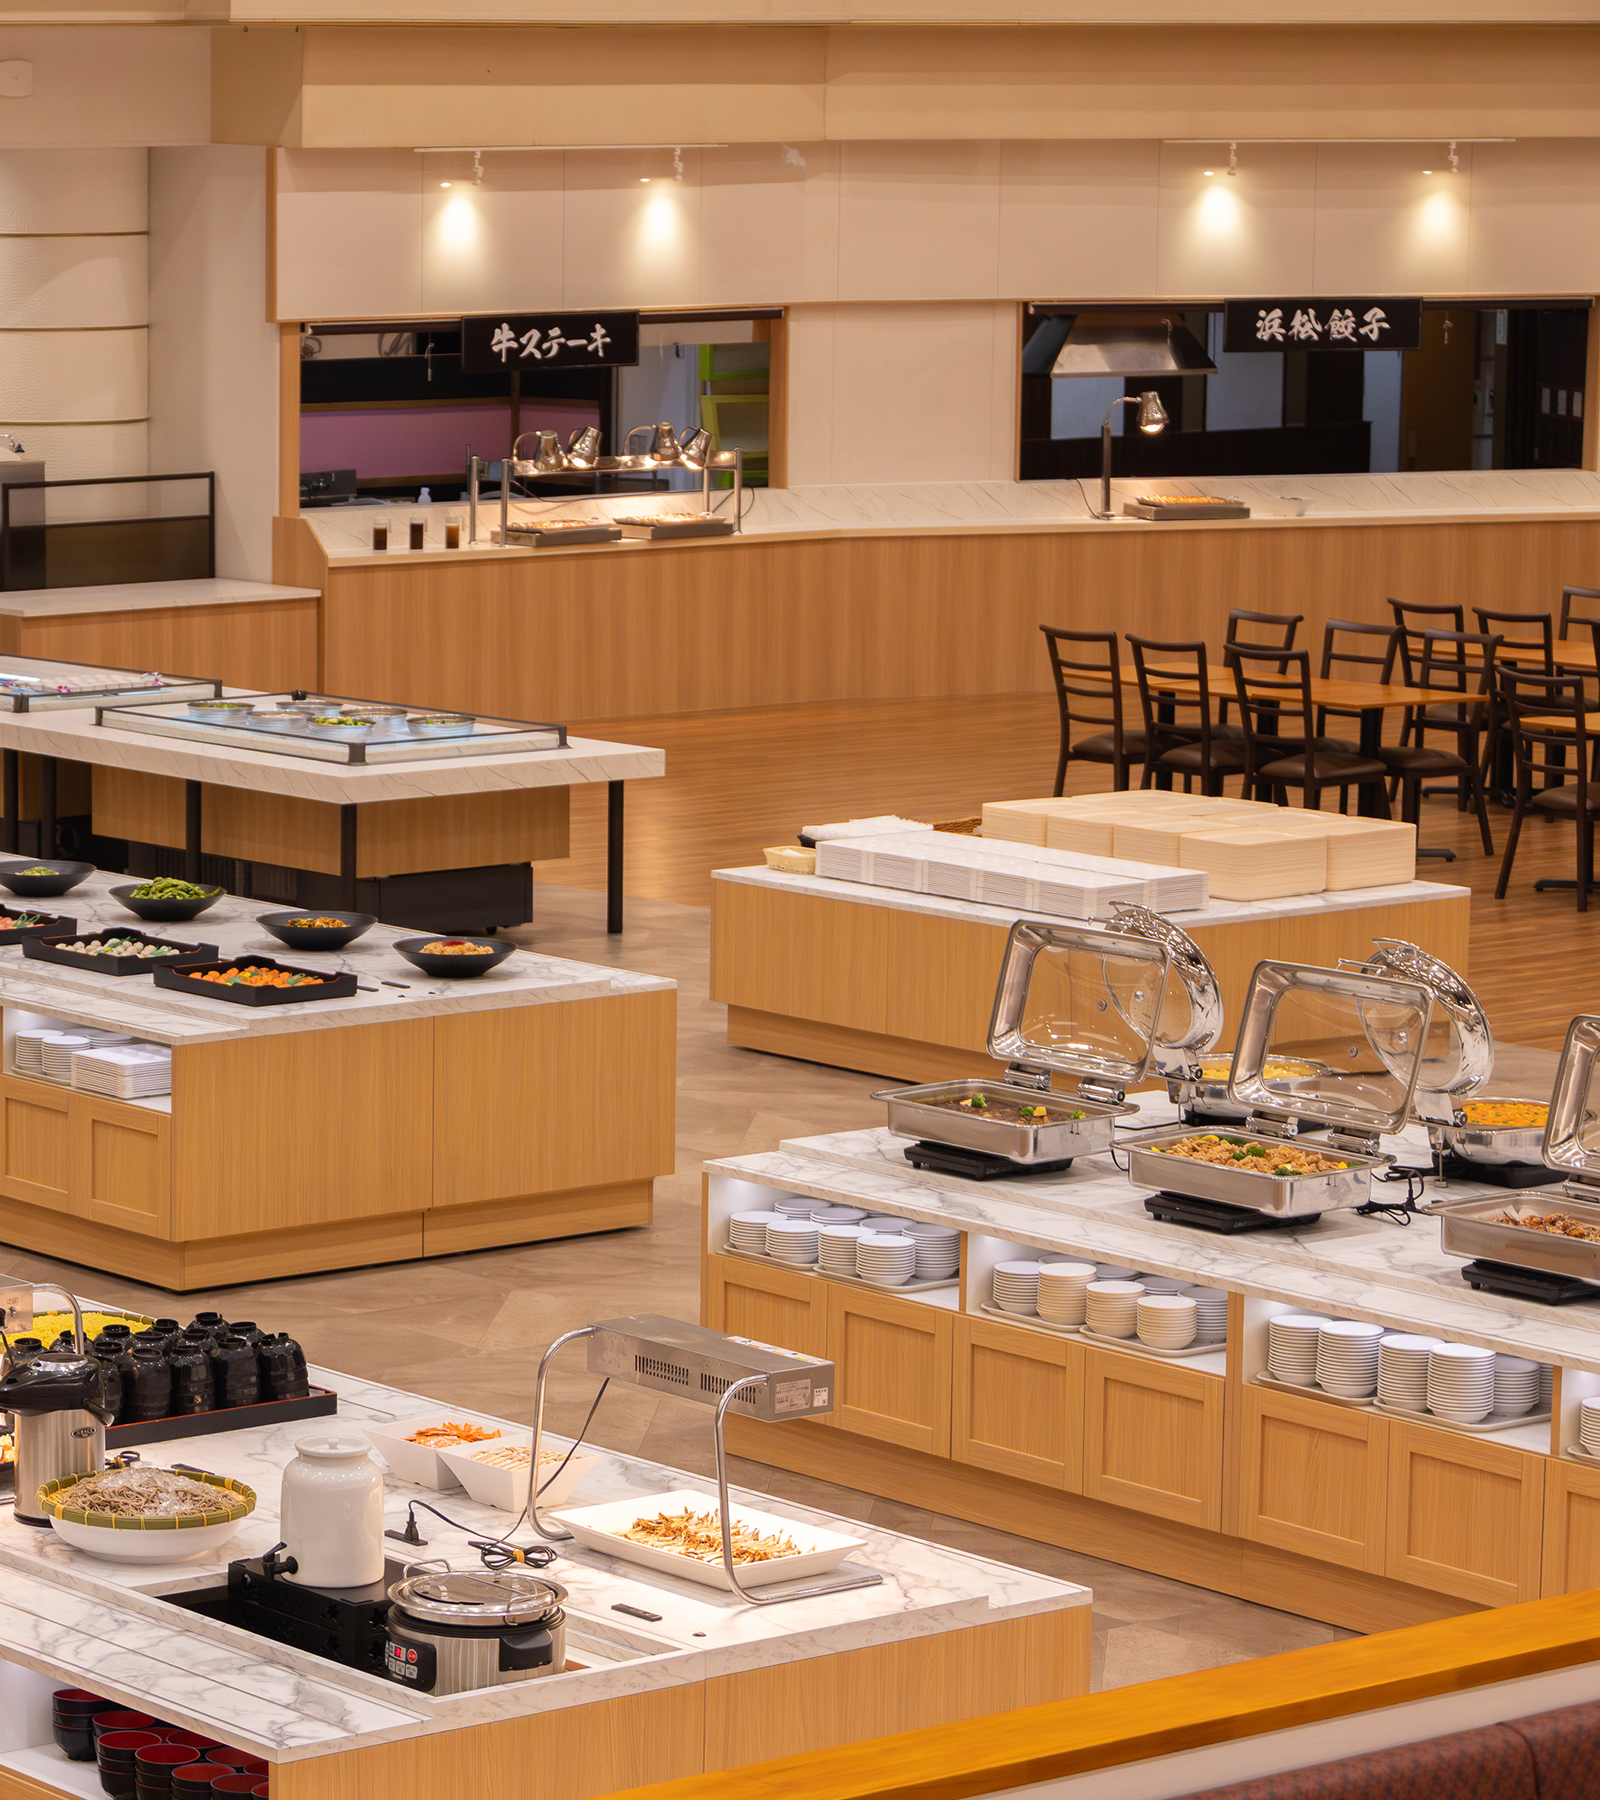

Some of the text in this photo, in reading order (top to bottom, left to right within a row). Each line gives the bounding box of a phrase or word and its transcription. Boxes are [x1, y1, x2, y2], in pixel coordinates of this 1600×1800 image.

[490, 322, 612, 364] 牛ステーキ
[1255, 306, 1391, 343] 浜松餃子
